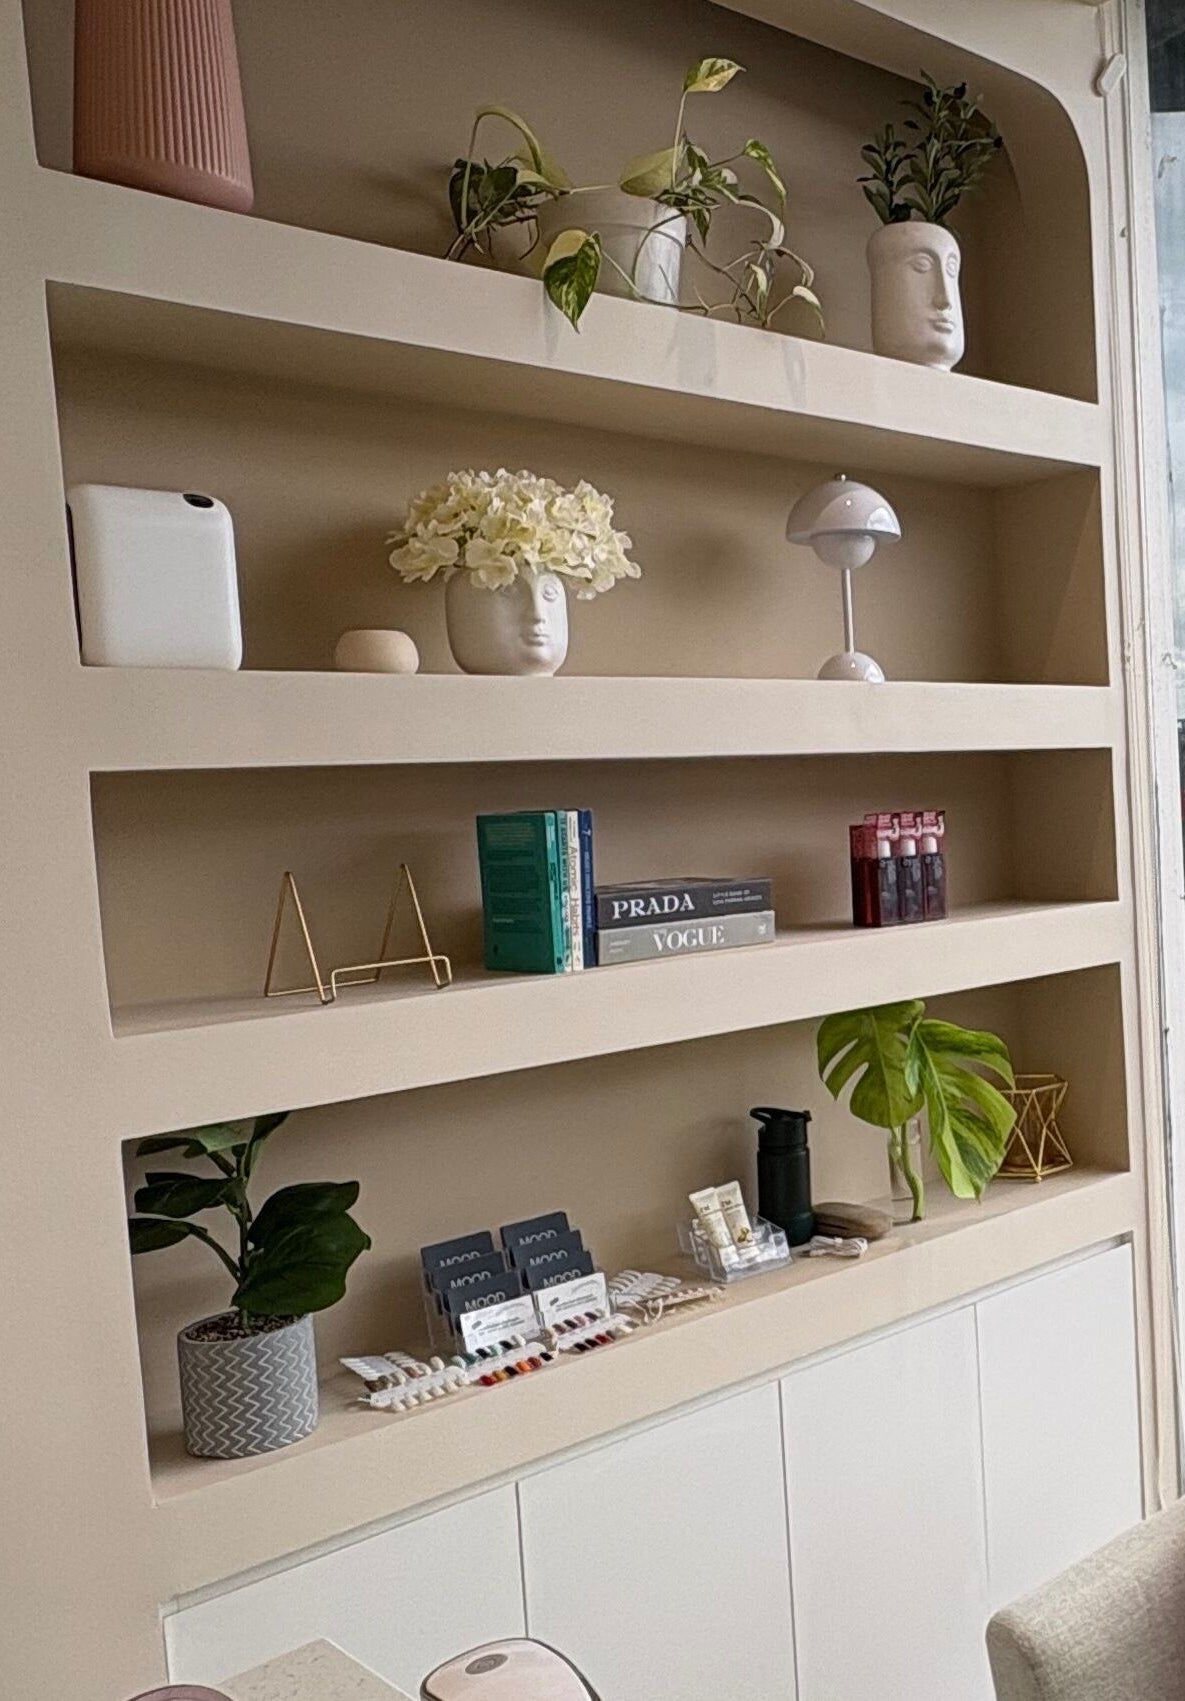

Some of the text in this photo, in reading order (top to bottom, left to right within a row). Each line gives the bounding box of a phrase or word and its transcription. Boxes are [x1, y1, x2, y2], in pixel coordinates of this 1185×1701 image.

[567, 846, 578, 892] Atomic
[570, 898, 580, 936] Habits
[612, 893, 695, 920] PRADA
[653, 926, 725, 952] VOGUE
[464, 1291, 506, 1312] MOOD
